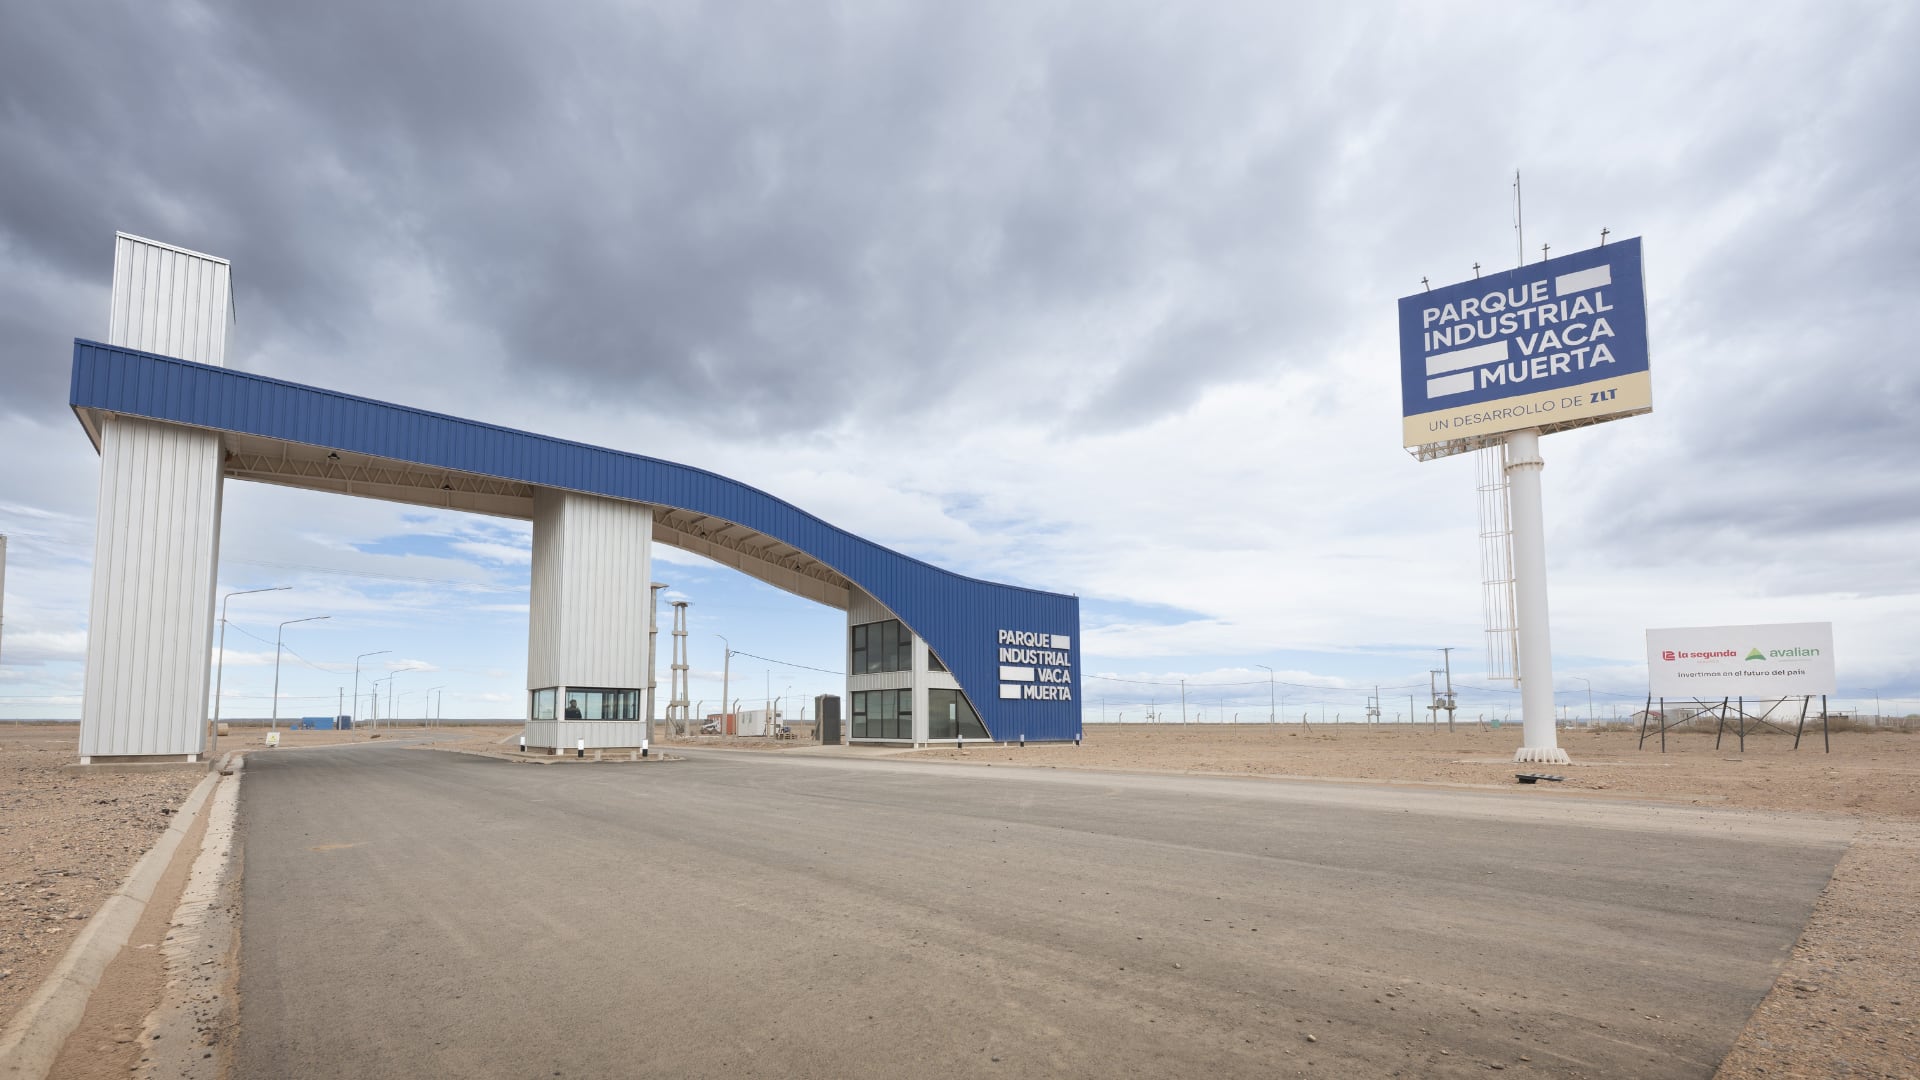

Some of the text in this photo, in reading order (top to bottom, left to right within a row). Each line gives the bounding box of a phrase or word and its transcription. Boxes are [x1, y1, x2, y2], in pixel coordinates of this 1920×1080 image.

[1423, 279, 1549, 329] PARQUE
[1424, 290, 1614, 352] INDUSTRIAL
[1515, 318, 1616, 356] VACA
[1480, 343, 1616, 389] MUERTA
[1429, 388, 1618, 432] UN DESARROLLO DE ZLT
[998, 629, 1050, 648] PARQUE
[999, 647, 1071, 667] INDUSTRIAL
[1678, 649, 1737, 660] la segunda
[1769, 647, 1820, 658] avalian
[1037, 667, 1071, 684] VACA
[1023, 684, 1072, 701] MUERTA
